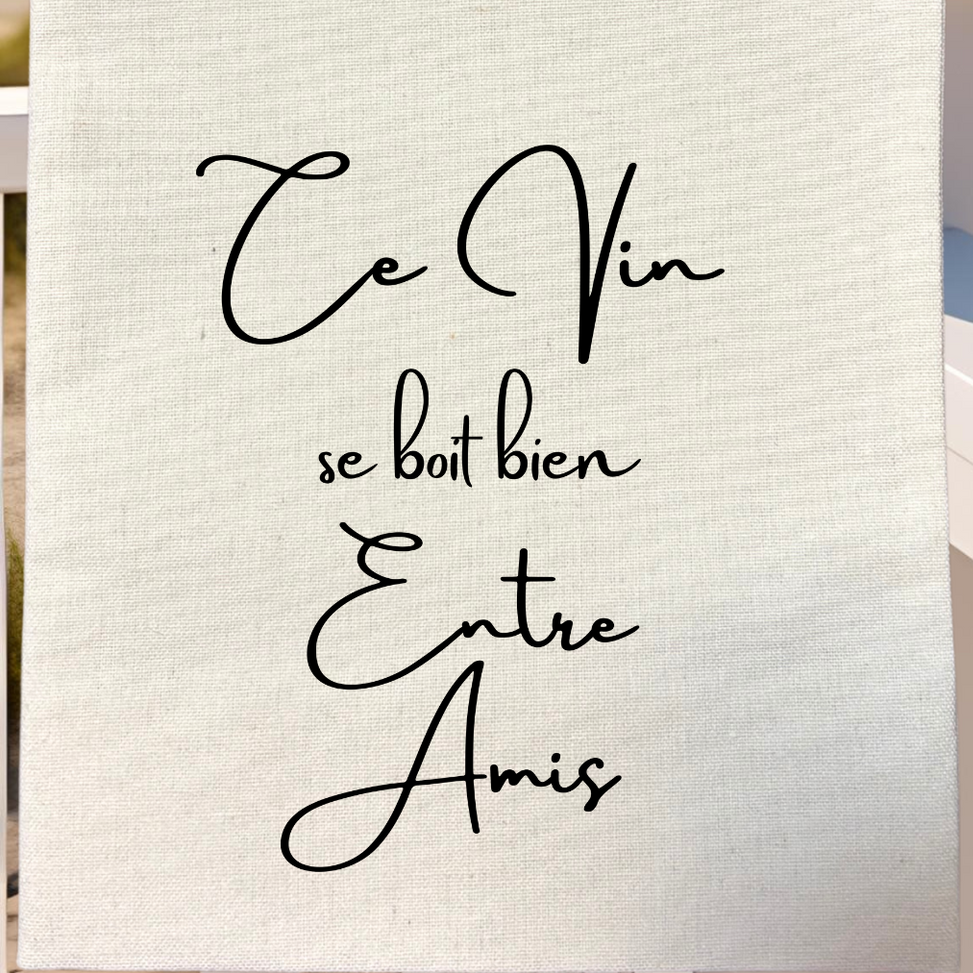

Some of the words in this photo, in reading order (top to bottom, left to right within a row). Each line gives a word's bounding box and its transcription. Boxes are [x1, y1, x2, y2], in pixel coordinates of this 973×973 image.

[195, 149, 429, 345] Ce
[456, 144, 725, 365] Vin
[318, 451, 378, 484] se
[393, 368, 484, 488] boit
[496, 368, 642, 481] bien
[306, 521, 640, 691] Entre
[280, 660, 623, 873] Amis
